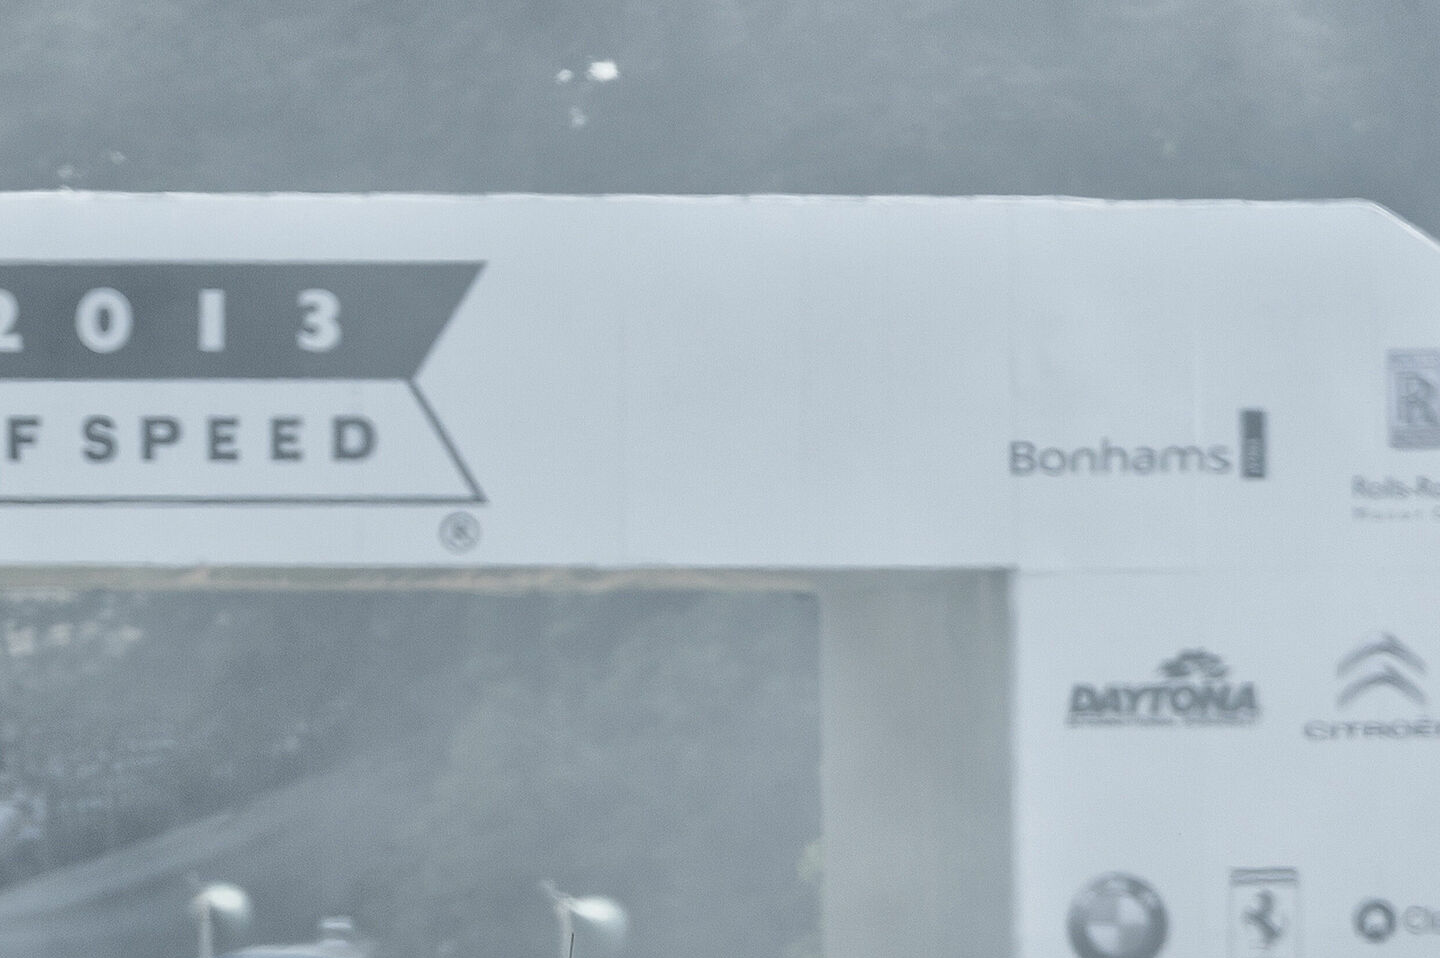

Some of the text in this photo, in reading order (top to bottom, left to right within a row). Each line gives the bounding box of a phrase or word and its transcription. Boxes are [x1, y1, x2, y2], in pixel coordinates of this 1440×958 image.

[80, 414, 379, 463] SPEED
[1009, 438, 1233, 475] Bonhams
[1068, 682, 1258, 713] DAYTONA
